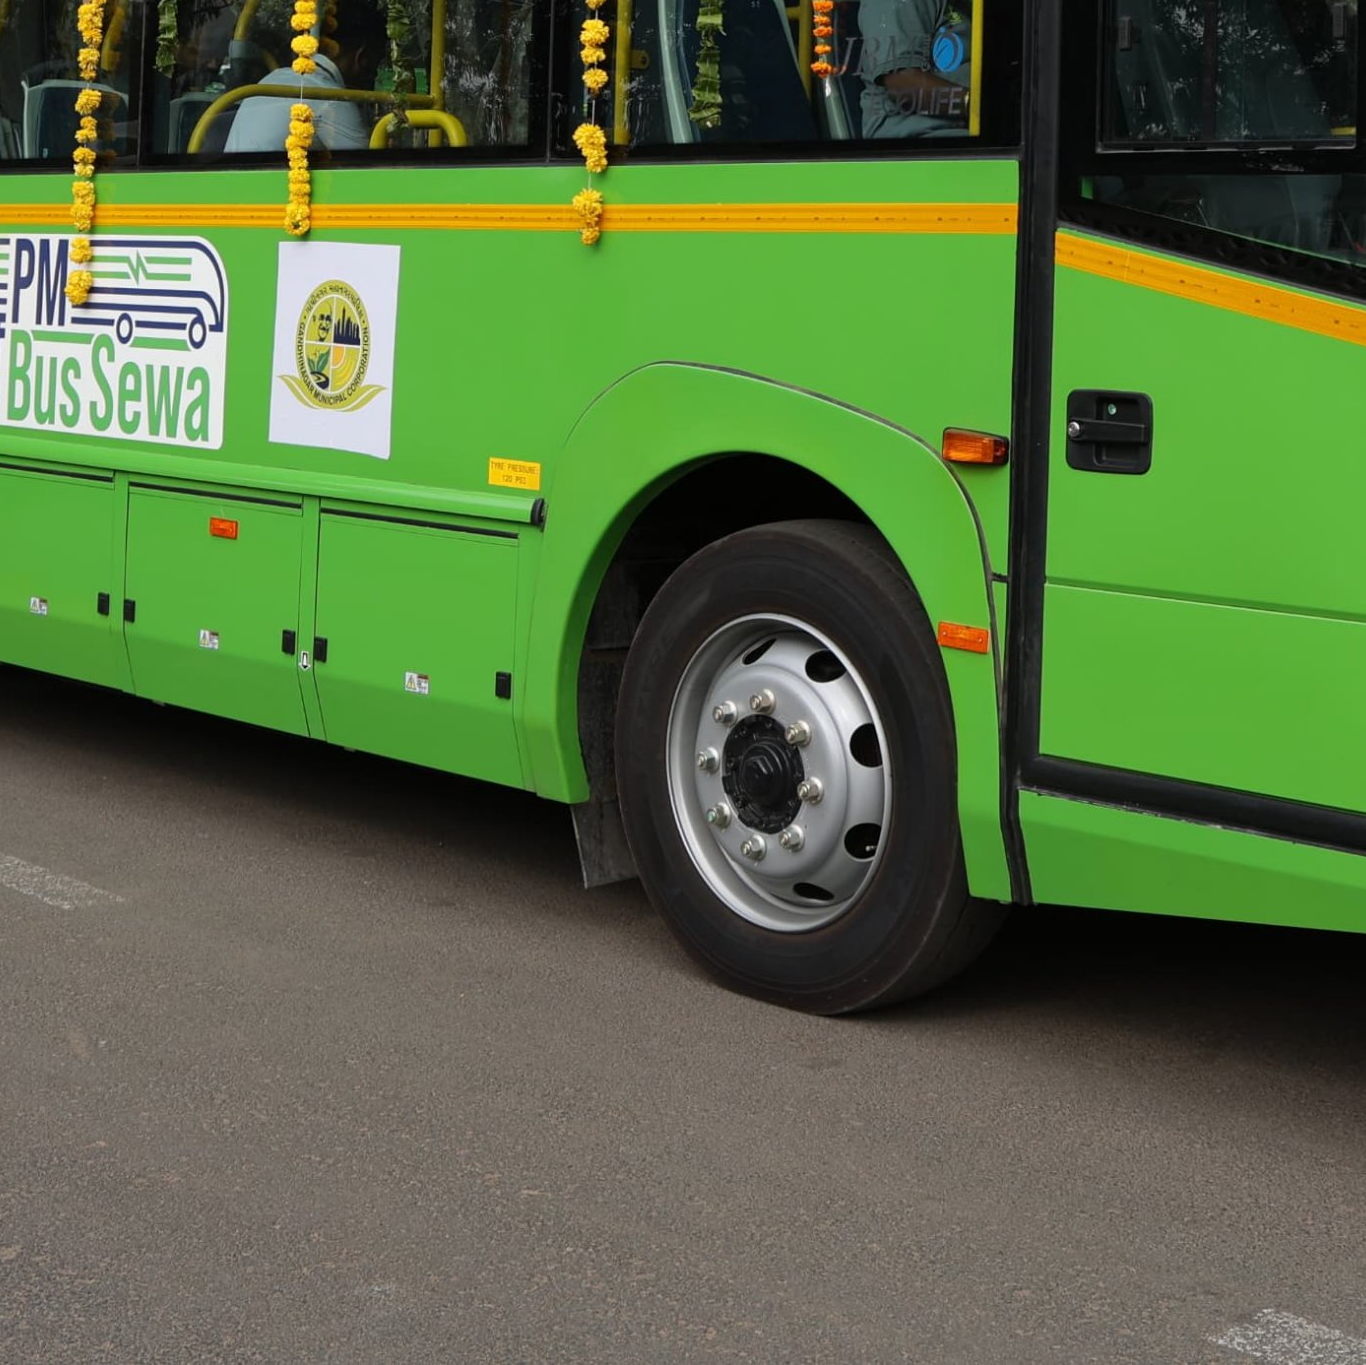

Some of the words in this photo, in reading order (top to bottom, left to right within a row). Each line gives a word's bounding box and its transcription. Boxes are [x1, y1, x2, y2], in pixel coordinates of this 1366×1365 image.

[11, 238, 69, 326] PM
[7, 329, 81, 428] Bus
[89, 333, 211, 442] Sewa
[297, 322, 315, 396] GANDHINAGAR
[313, 390, 347, 405] MUNICIPAL
[347, 326, 369, 396] CORPORATION
